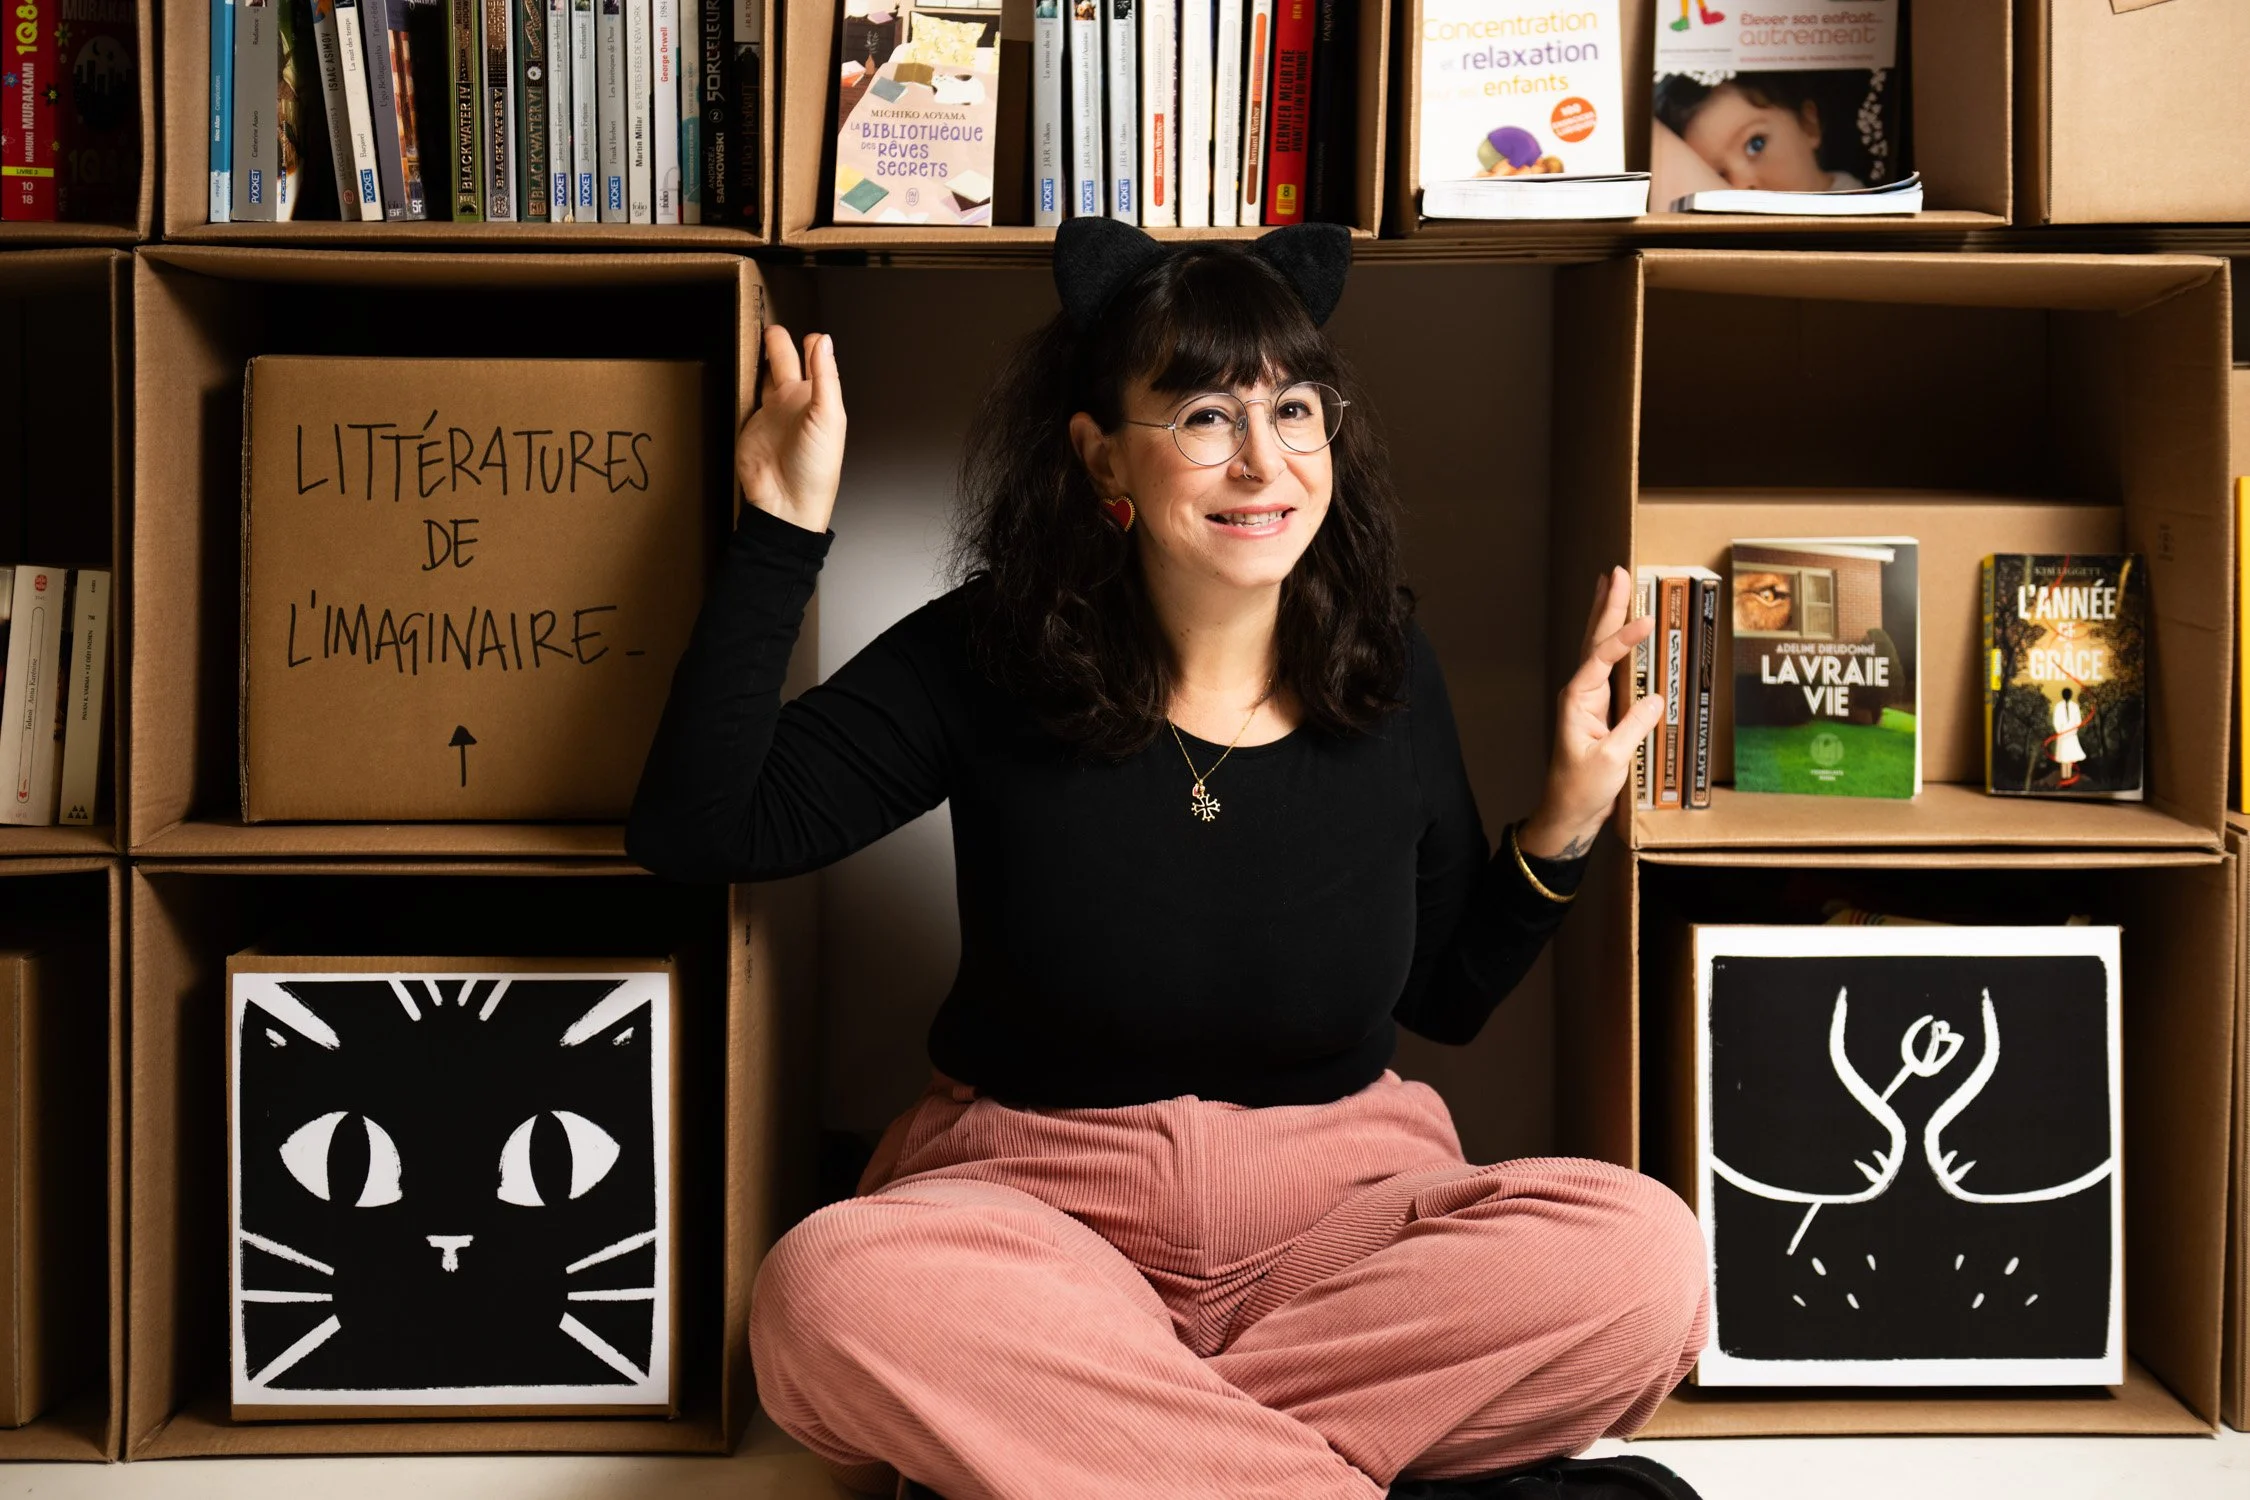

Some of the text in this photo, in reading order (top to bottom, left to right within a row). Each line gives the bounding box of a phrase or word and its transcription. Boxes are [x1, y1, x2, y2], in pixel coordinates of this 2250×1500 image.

[1322, 3, 1333, 42] FANTASY
[1423, 10, 1598, 42] Concentration
[1739, 27, 1876, 45] autrement
[345, 18, 356, 71] La nuit des temps
[608, 44, 615, 53] de
[634, 44, 642, 54] DE
[660, 27, 669, 82] George Orwell
[1462, 40, 1599, 71] relaxation
[321, 32, 338, 91] ISAAC ASIMOV
[375, 45, 387, 89] Bellagamba
[380, 91, 388, 108] Ugo
[459, 86, 471, 99] IV
[528, 88, 541, 102] VI
[1276, 49, 1295, 152] DERNIER MEURTRE
[1483, 72, 1569, 97] enfants
[22, 63, 34, 162] HARUKI MURAKAMI
[871, 109, 966, 120] MICHIKO AOYAMA
[358, 133, 367, 158] Barjavel
[460, 103, 472, 190] BLACKWATER
[494, 98, 504, 188] BLACKWATER
[529, 103, 544, 199] BLACKWATER
[635, 116, 643, 167] Martin Millar
[1249, 107, 1260, 165] Bernard Werber
[1293, 127, 1303, 152] AVANT
[609, 145, 617, 164] Frank
[715, 132, 725, 204] SAPKOWSKI
[22, 181, 34, 191] 10
[22, 194, 34, 205] 18
[250, 169, 260, 204] POCKET
[361, 169, 375, 203] POCKET
[556, 173, 566, 206] POCKET
[581, 173, 591, 206] POCKET
[610, 176, 620, 210] POCKET
[659, 190, 669, 208] folio
[1043, 178, 1053, 211] POCKET
[1083, 180, 1094, 213] POCKET
[1119, 179, 1130, 212] POCKET
[412, 200, 422, 213] SF
[297, 409, 652, 502] LITTÉRATURES
[421, 518, 479, 571] DE
[2018, 578, 2117, 620] L'ANNÉE
[1776, 643, 1876, 654] ADELINE DIEUDONNÉ
[29, 658, 38, 686] Karénine
[1761, 654, 1889, 687] LA VRAIE
[27, 687, 36, 704] Anna
[1802, 686, 1849, 716] VIE
[1696, 707, 1708, 787] BLACKWATER
